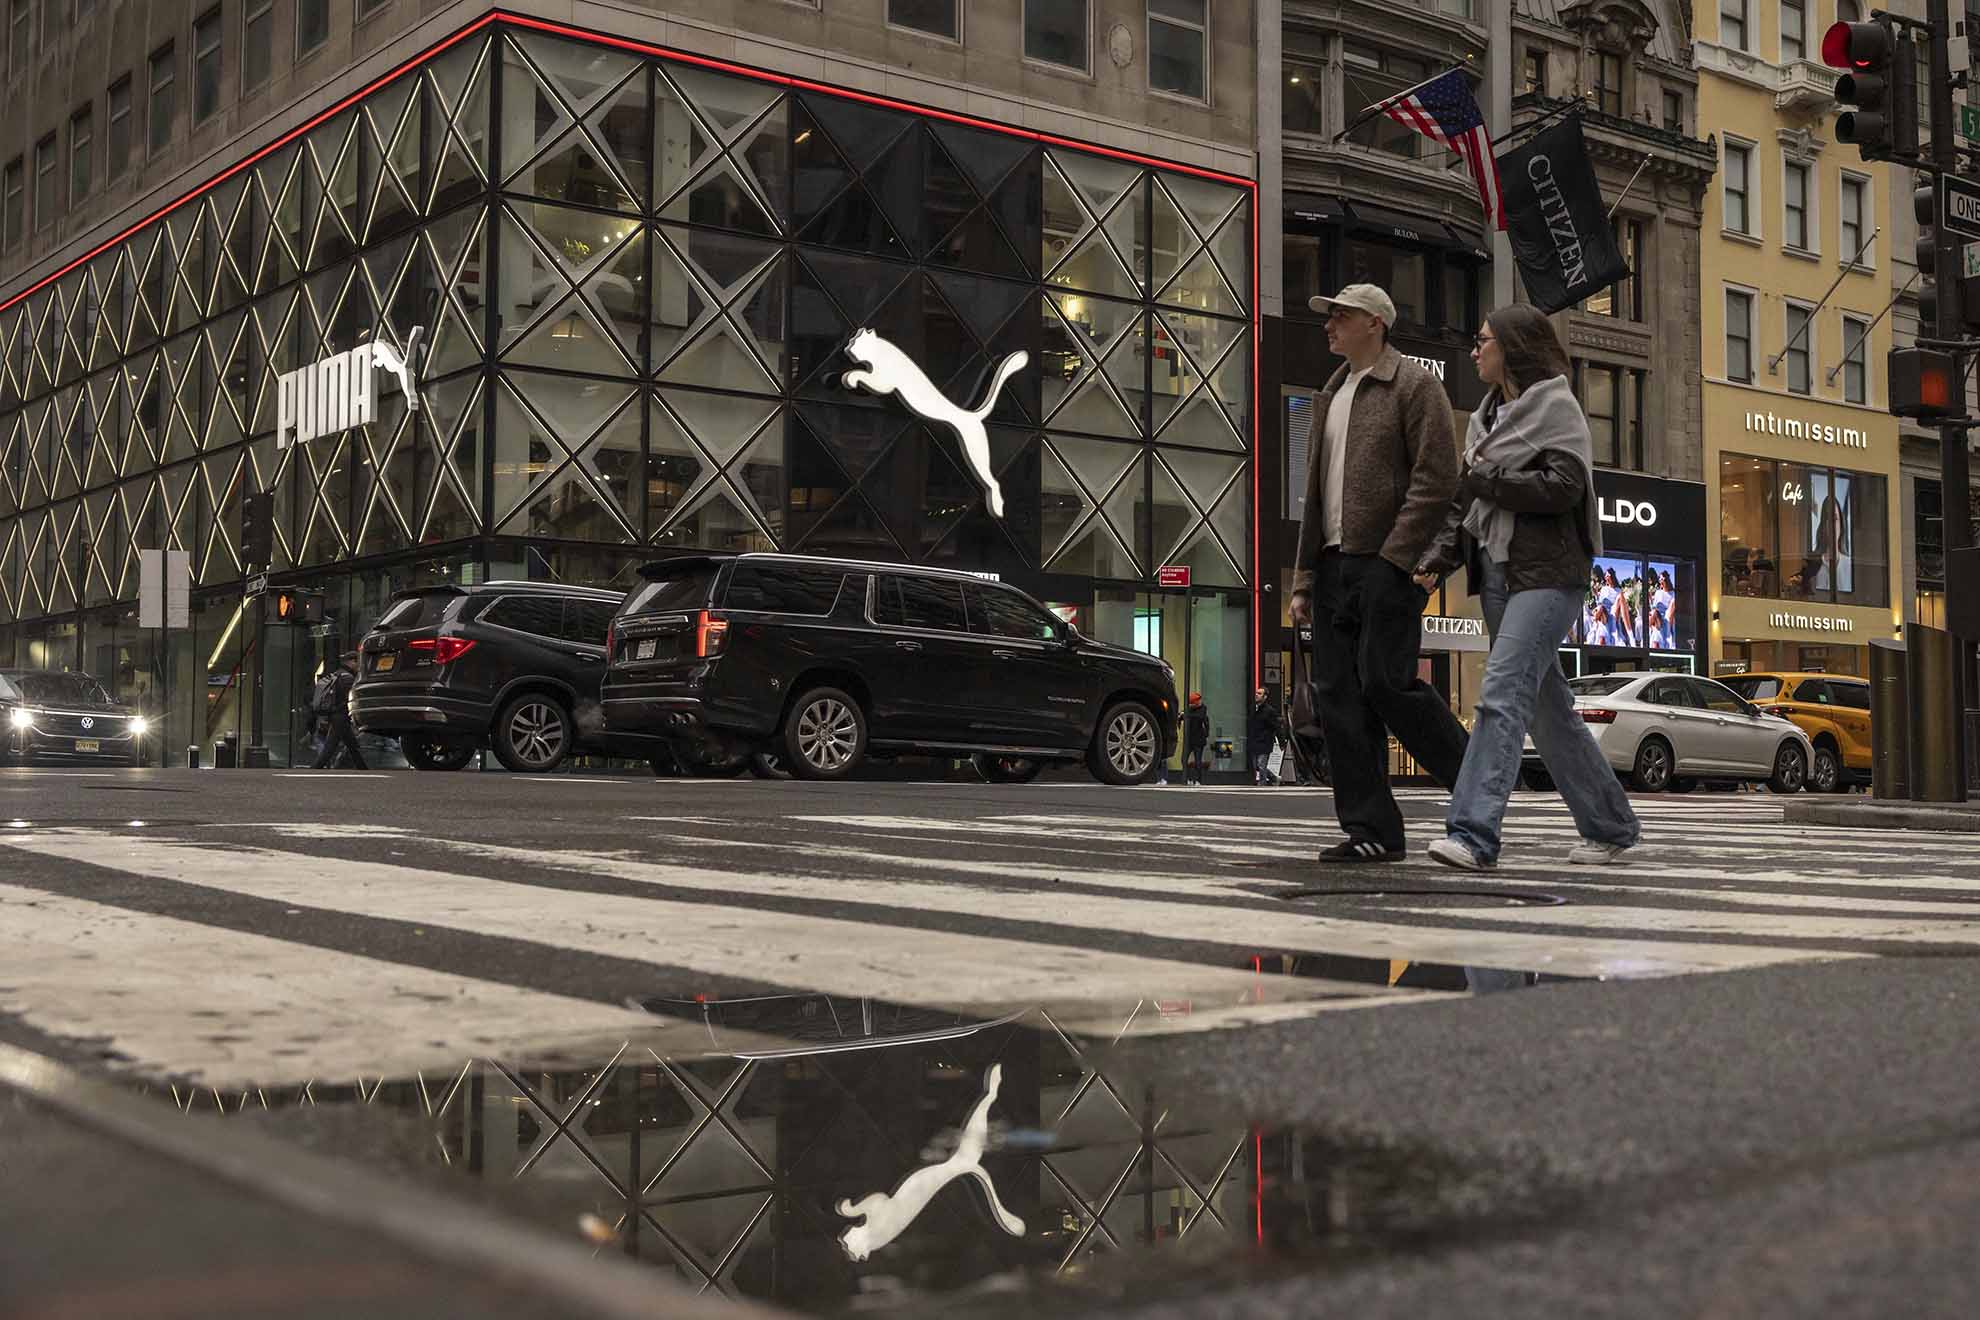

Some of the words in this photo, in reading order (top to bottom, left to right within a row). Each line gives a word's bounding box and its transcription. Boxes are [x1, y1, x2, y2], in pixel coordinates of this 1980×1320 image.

[1528, 154, 1588, 289] CITIZEN
[277, 343, 375, 449] PUMA
[1746, 411, 1867, 449] intimissimi
[1598, 497, 1657, 526] LDO
[1424, 616, 1483, 635] CITIZEN
[1769, 612, 1853, 631] intimissimi
